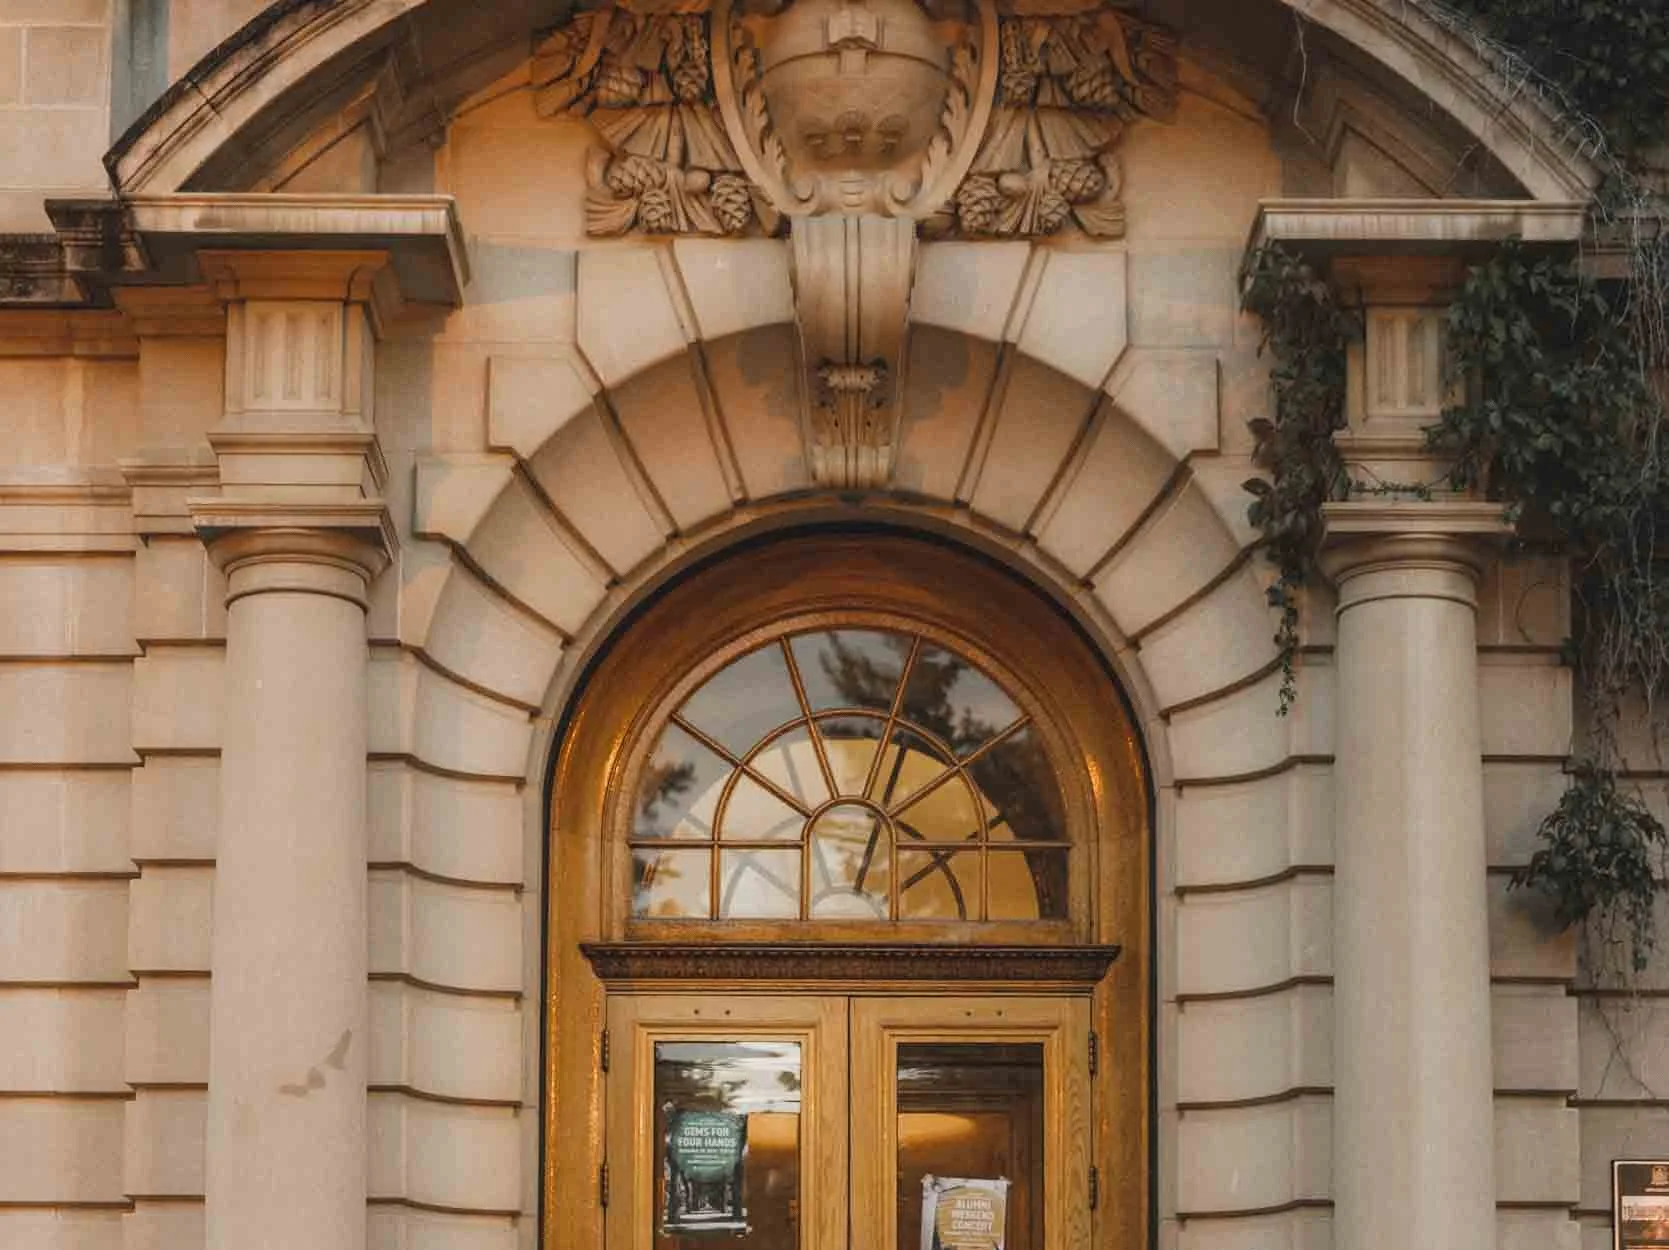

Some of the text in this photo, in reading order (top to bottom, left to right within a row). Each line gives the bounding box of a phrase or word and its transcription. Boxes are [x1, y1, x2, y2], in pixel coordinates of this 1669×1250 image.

[684, 1127, 729, 1137] GEMS FOR
[678, 1137, 738, 1148] FOUR HANDS
[955, 1199, 993, 1209] ALUMNI
[952, 1220, 993, 1232] CONCERT
